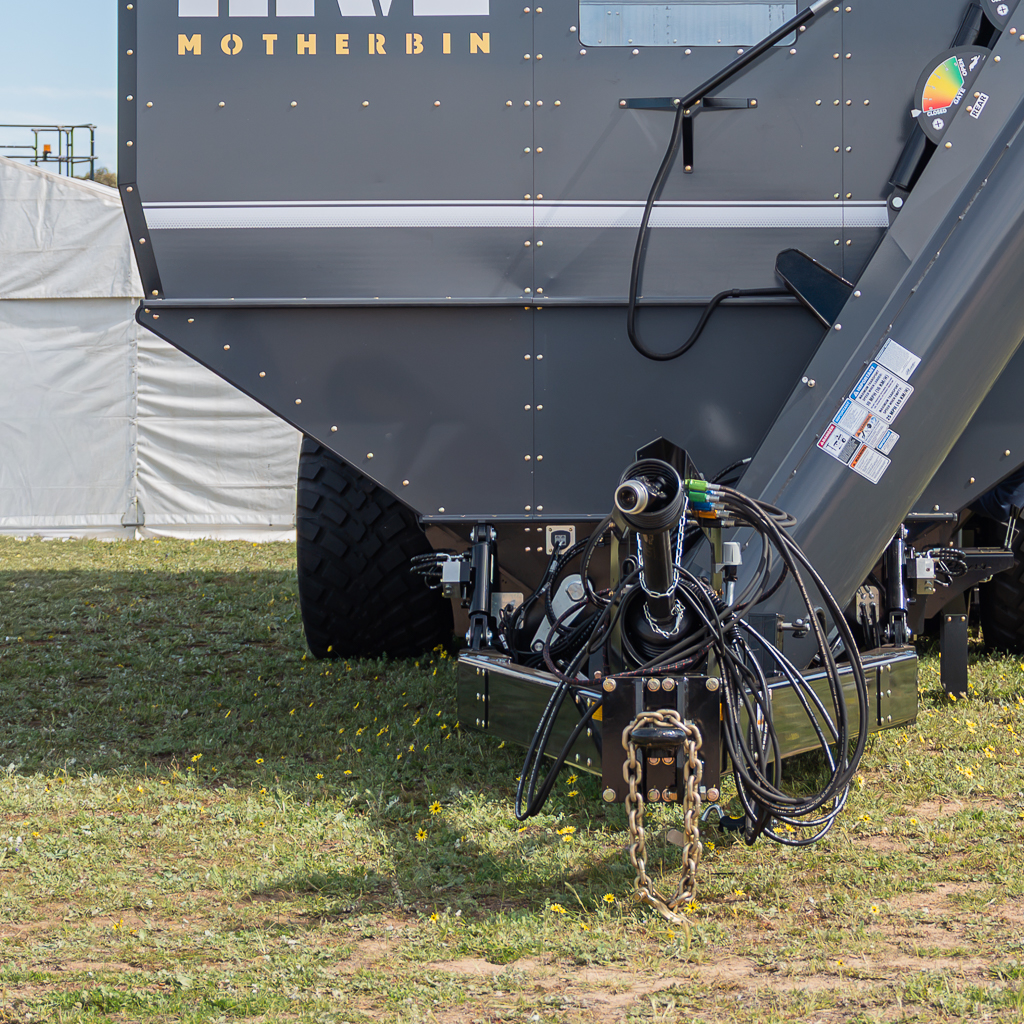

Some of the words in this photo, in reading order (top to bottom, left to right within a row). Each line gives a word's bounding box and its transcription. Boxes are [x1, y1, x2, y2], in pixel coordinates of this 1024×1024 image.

[177, 33, 490, 55] MOTHERBIN
[958, 58, 968, 76] OPEN
[954, 88, 966, 104] GATE
[971, 95, 987, 116] REAR
[926, 108, 948, 116] CLOSED
[857, 366, 875, 391] IMPORTANT
